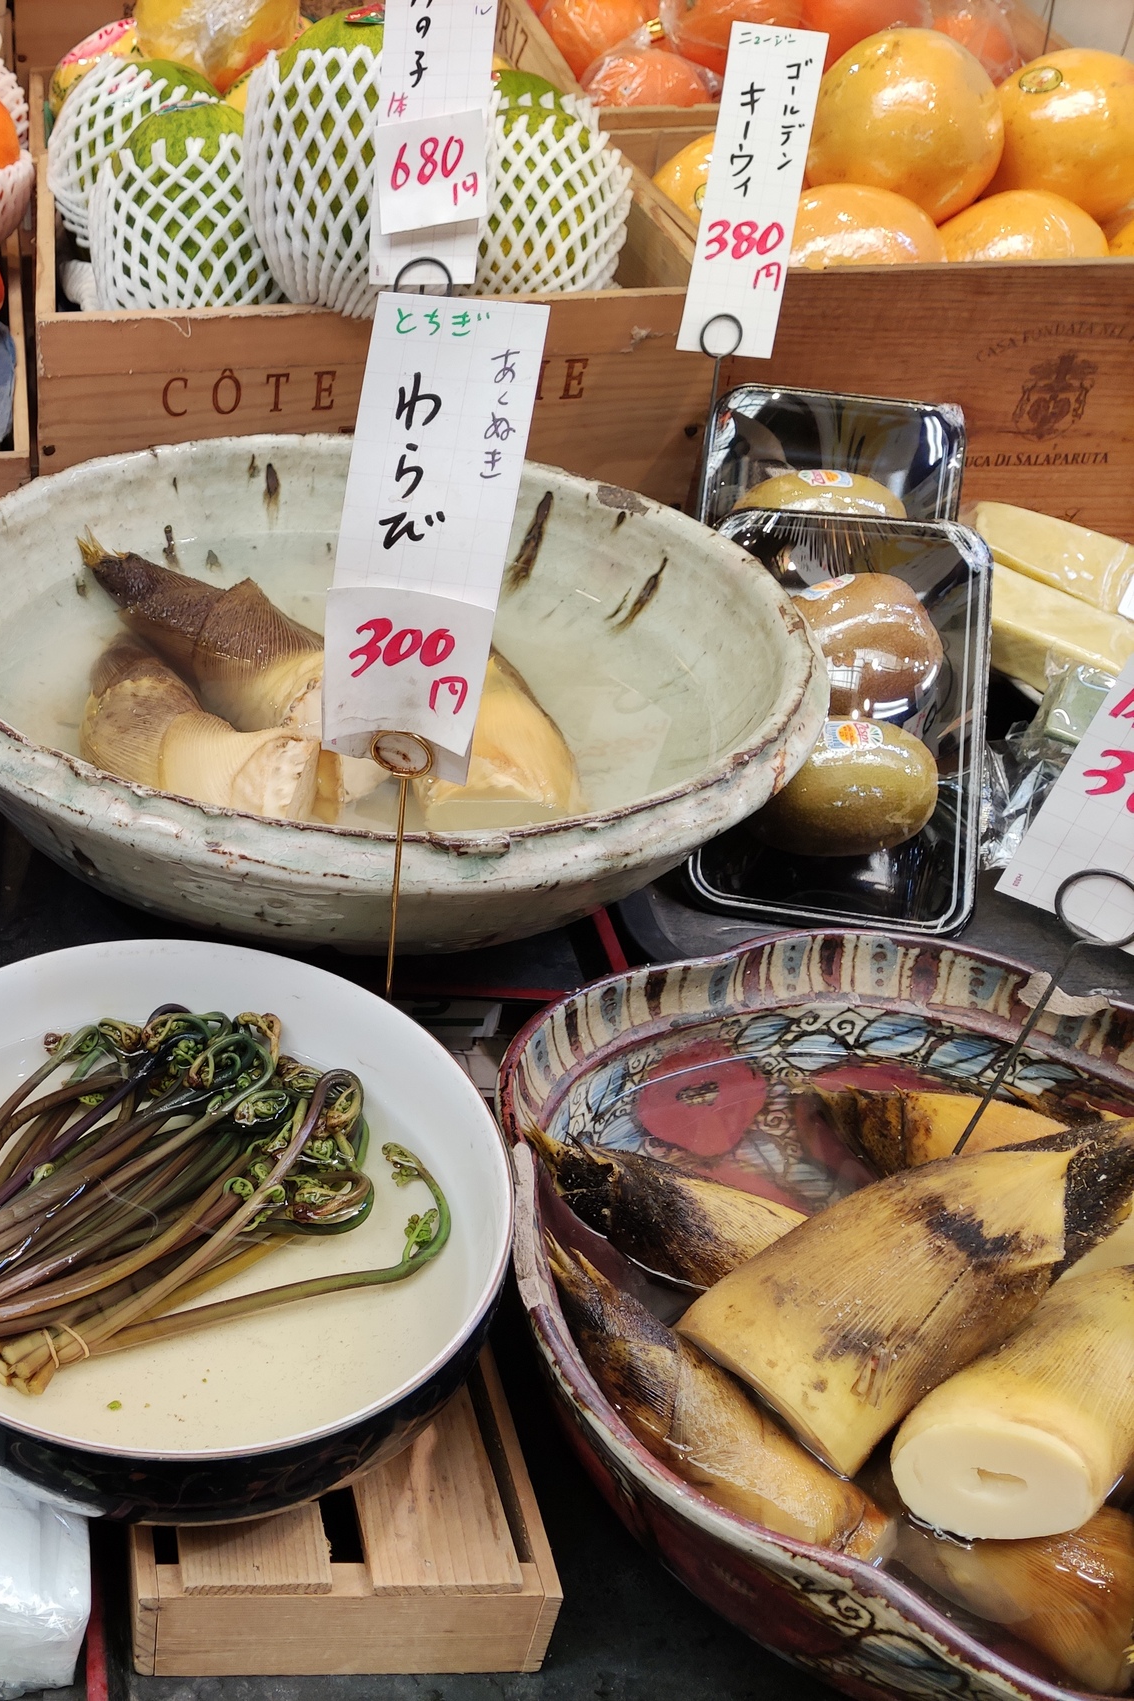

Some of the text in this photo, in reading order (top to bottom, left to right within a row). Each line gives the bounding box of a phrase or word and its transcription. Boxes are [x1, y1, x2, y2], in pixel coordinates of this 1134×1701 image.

[409, 0, 434, 88] の子
[777, 58, 813, 171] ゴールデン
[390, 136, 464, 191] 680
[704, 219, 785, 291] 380 円
[396, 308, 490, 336] とちぎ
[162, 358, 589, 417] CÔTE IE
[479, 349, 521, 479] あくぬき
[378, 371, 446, 549] わらび
[964, 455, 991, 468] UCA
[348, 617, 469, 715] 300 円
